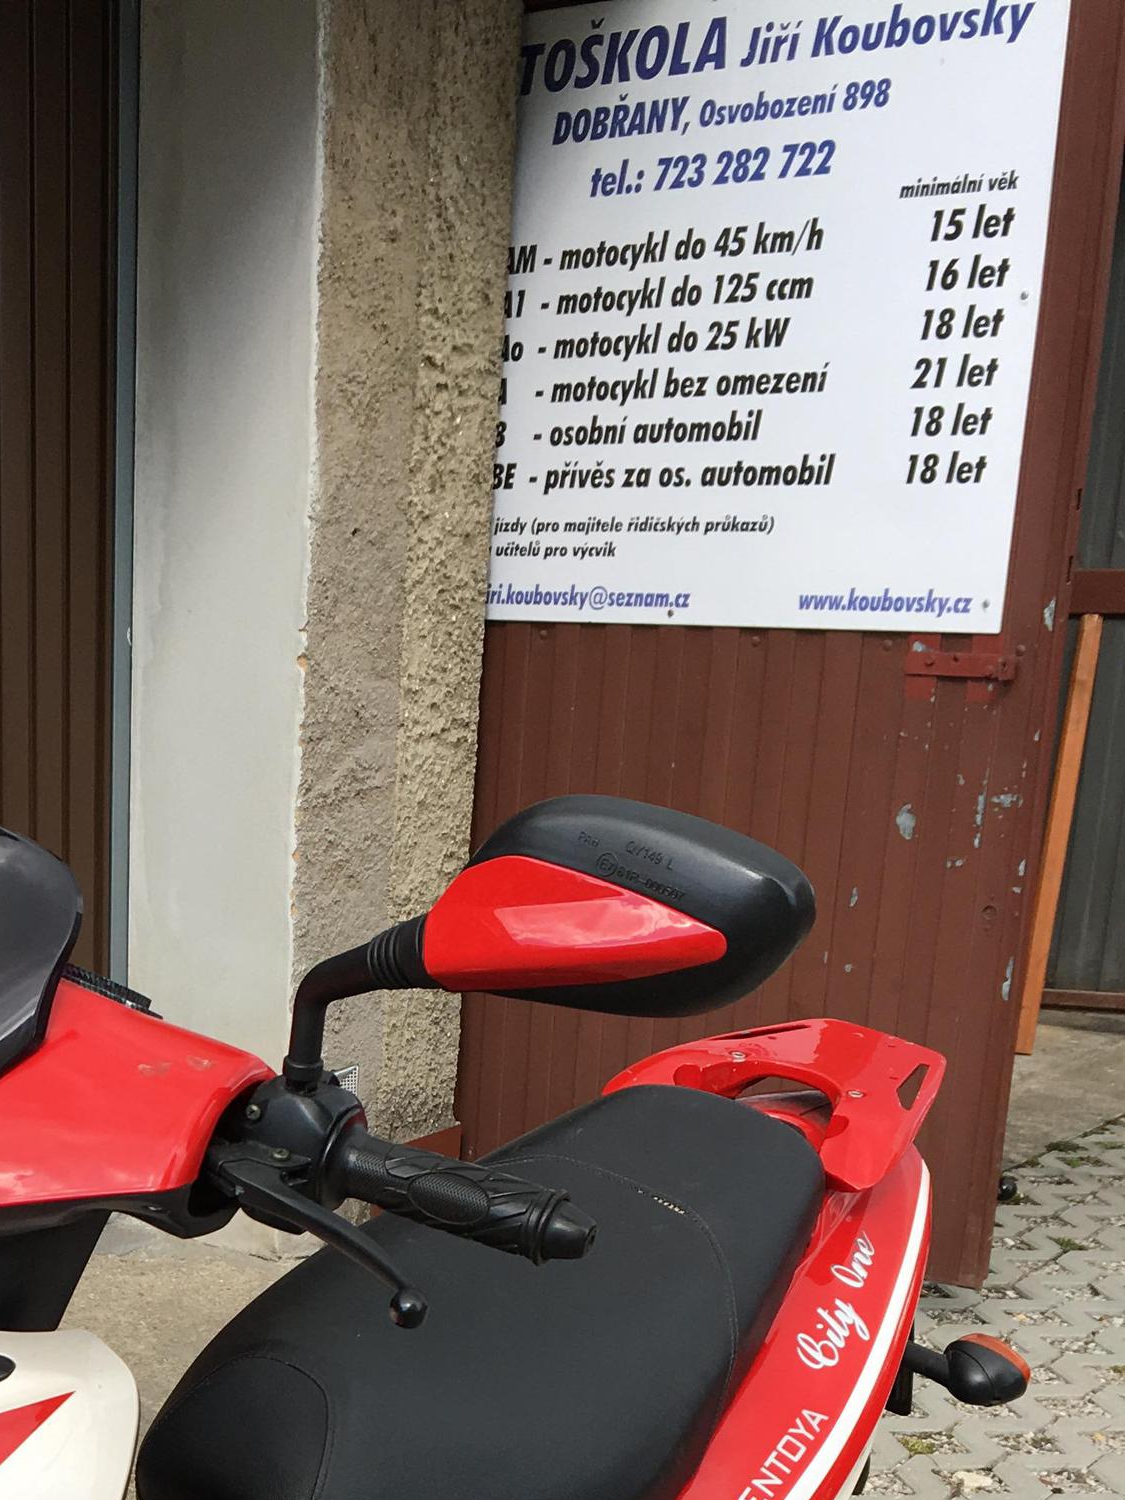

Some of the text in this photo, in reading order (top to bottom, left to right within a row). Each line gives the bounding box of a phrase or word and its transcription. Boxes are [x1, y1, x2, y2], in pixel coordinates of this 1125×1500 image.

[740, 20, 804, 67] Jiří
[552, 78, 892, 146] DOBŘANY, Osvobození 898
[590, 139, 836, 198] tel.: 723 282 722
[899, 170, 1019, 199] minimální věk
[930, 203, 1015, 242] 15 let
[559, 231, 670, 271] motocykl
[675, 227, 706, 261] do
[713, 225, 748, 257] 45
[753, 217, 825, 256] km/h
[925, 254, 1010, 292] 16 let
[556, 276, 666, 316] motocykl
[671, 274, 702, 308] do
[713, 271, 760, 305] 125
[766, 276, 814, 302] ccm
[553, 322, 662, 362] motocykl
[667, 320, 698, 354] do
[704, 320, 740, 352] 25
[745, 316, 791, 349] kW
[920, 304, 1004, 341] 18 let
[550, 367, 659, 407] motocykl
[663, 367, 709, 398] bez
[716, 362, 830, 396] omezení
[910, 353, 999, 389] 21 let
[549, 415, 628, 447] osobní
[633, 409, 763, 444] automobil
[911, 402, 993, 437] 18 let
[492, 463, 517, 490] BE
[543, 460, 616, 495] přívěs
[621, 466, 652, 488] za
[658, 466, 692, 488] os.
[700, 453, 836, 488] automobil
[905, 450, 987, 485] 18 let
[494, 514, 775, 536] jízdy (pro majitele řidičských průkazů)
[495, 540, 617, 560] učitelů pro výcvik
[798, 587, 973, 618] www.koubovsky.cz
[830, 1231, 875, 1288] One
